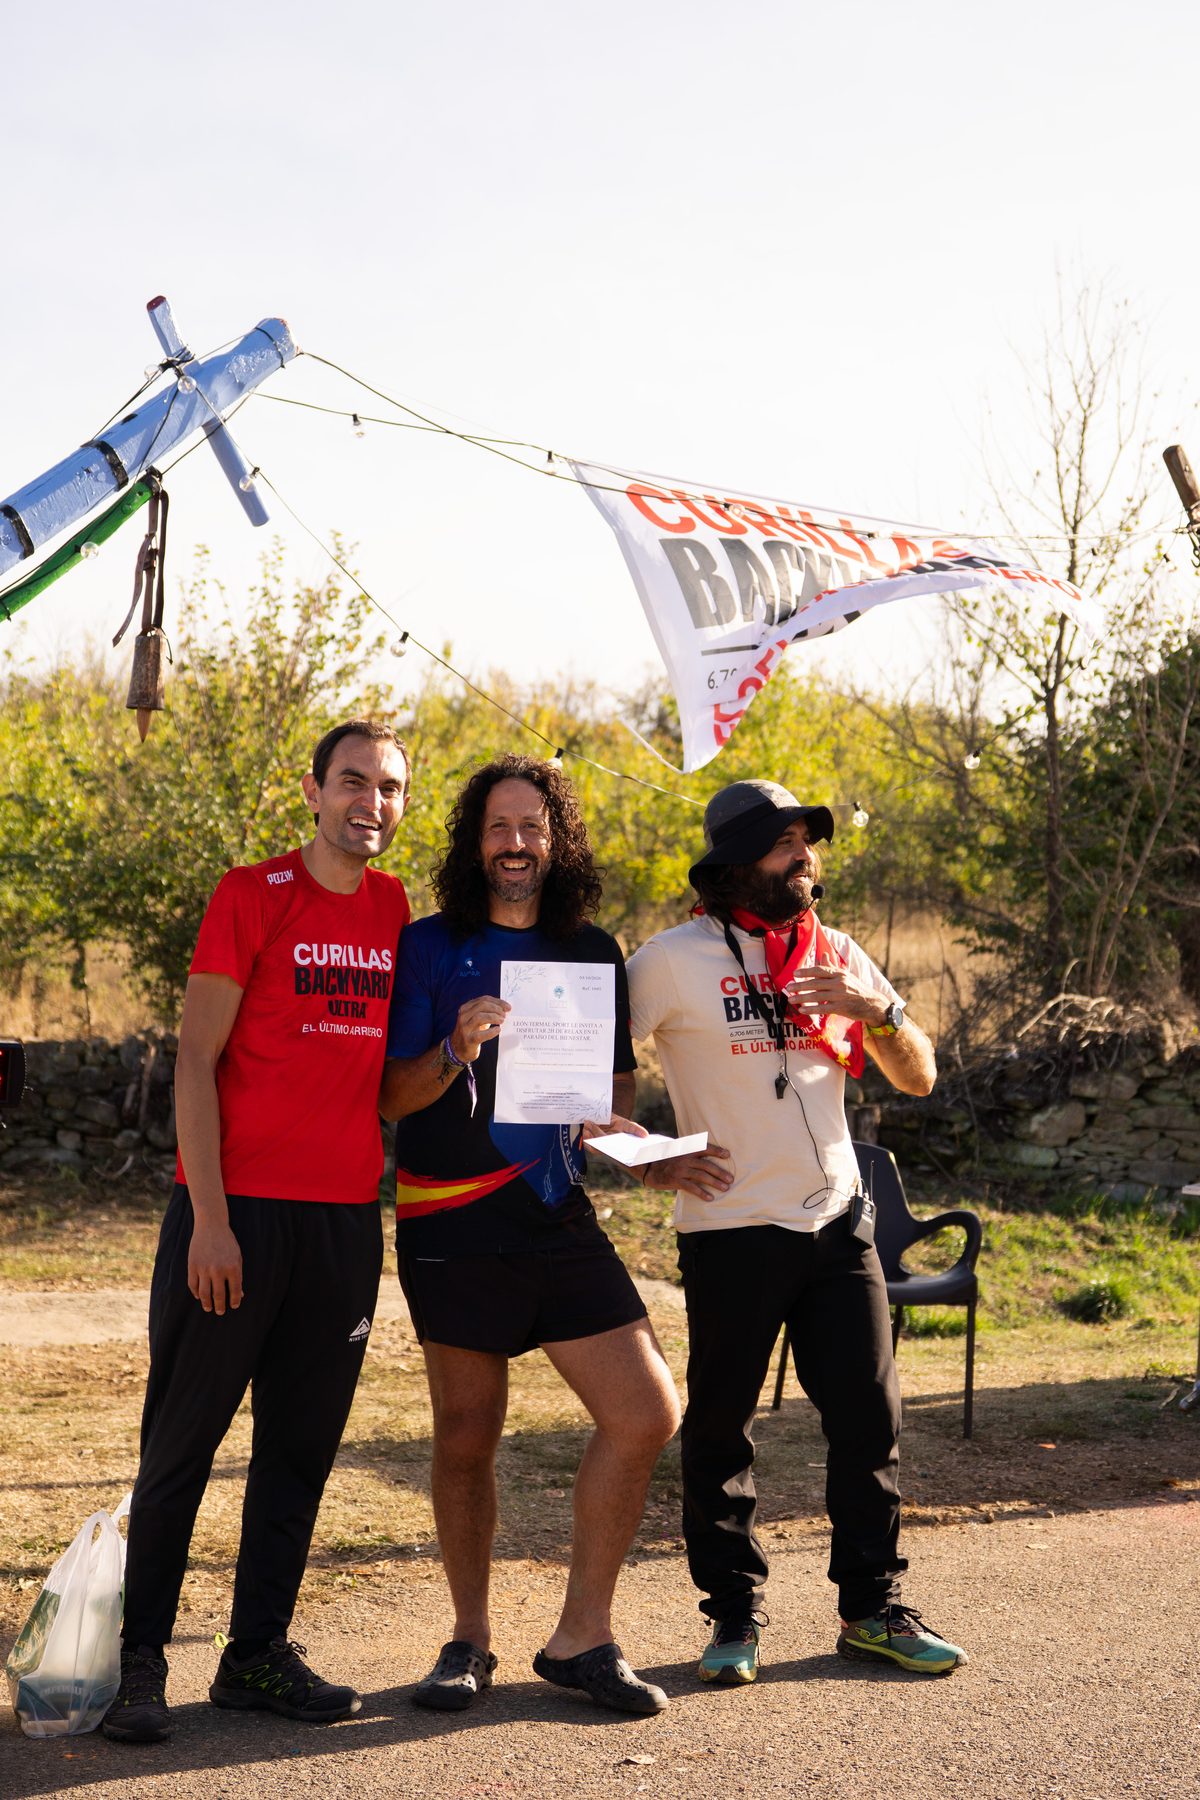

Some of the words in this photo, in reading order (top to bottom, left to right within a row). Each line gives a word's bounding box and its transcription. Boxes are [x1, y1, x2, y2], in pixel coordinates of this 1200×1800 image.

[293, 943, 393, 972] CURILLAS
[294, 967, 392, 1000] BACKYARD
[328, 1000, 367, 1019] ULTRA
[302, 1023, 317, 1033] EL
[319, 1020, 350, 1036] ÚLTIMO
[350, 1025, 383, 1038] ARRIERO
[731, 1043, 748, 1055] EL
